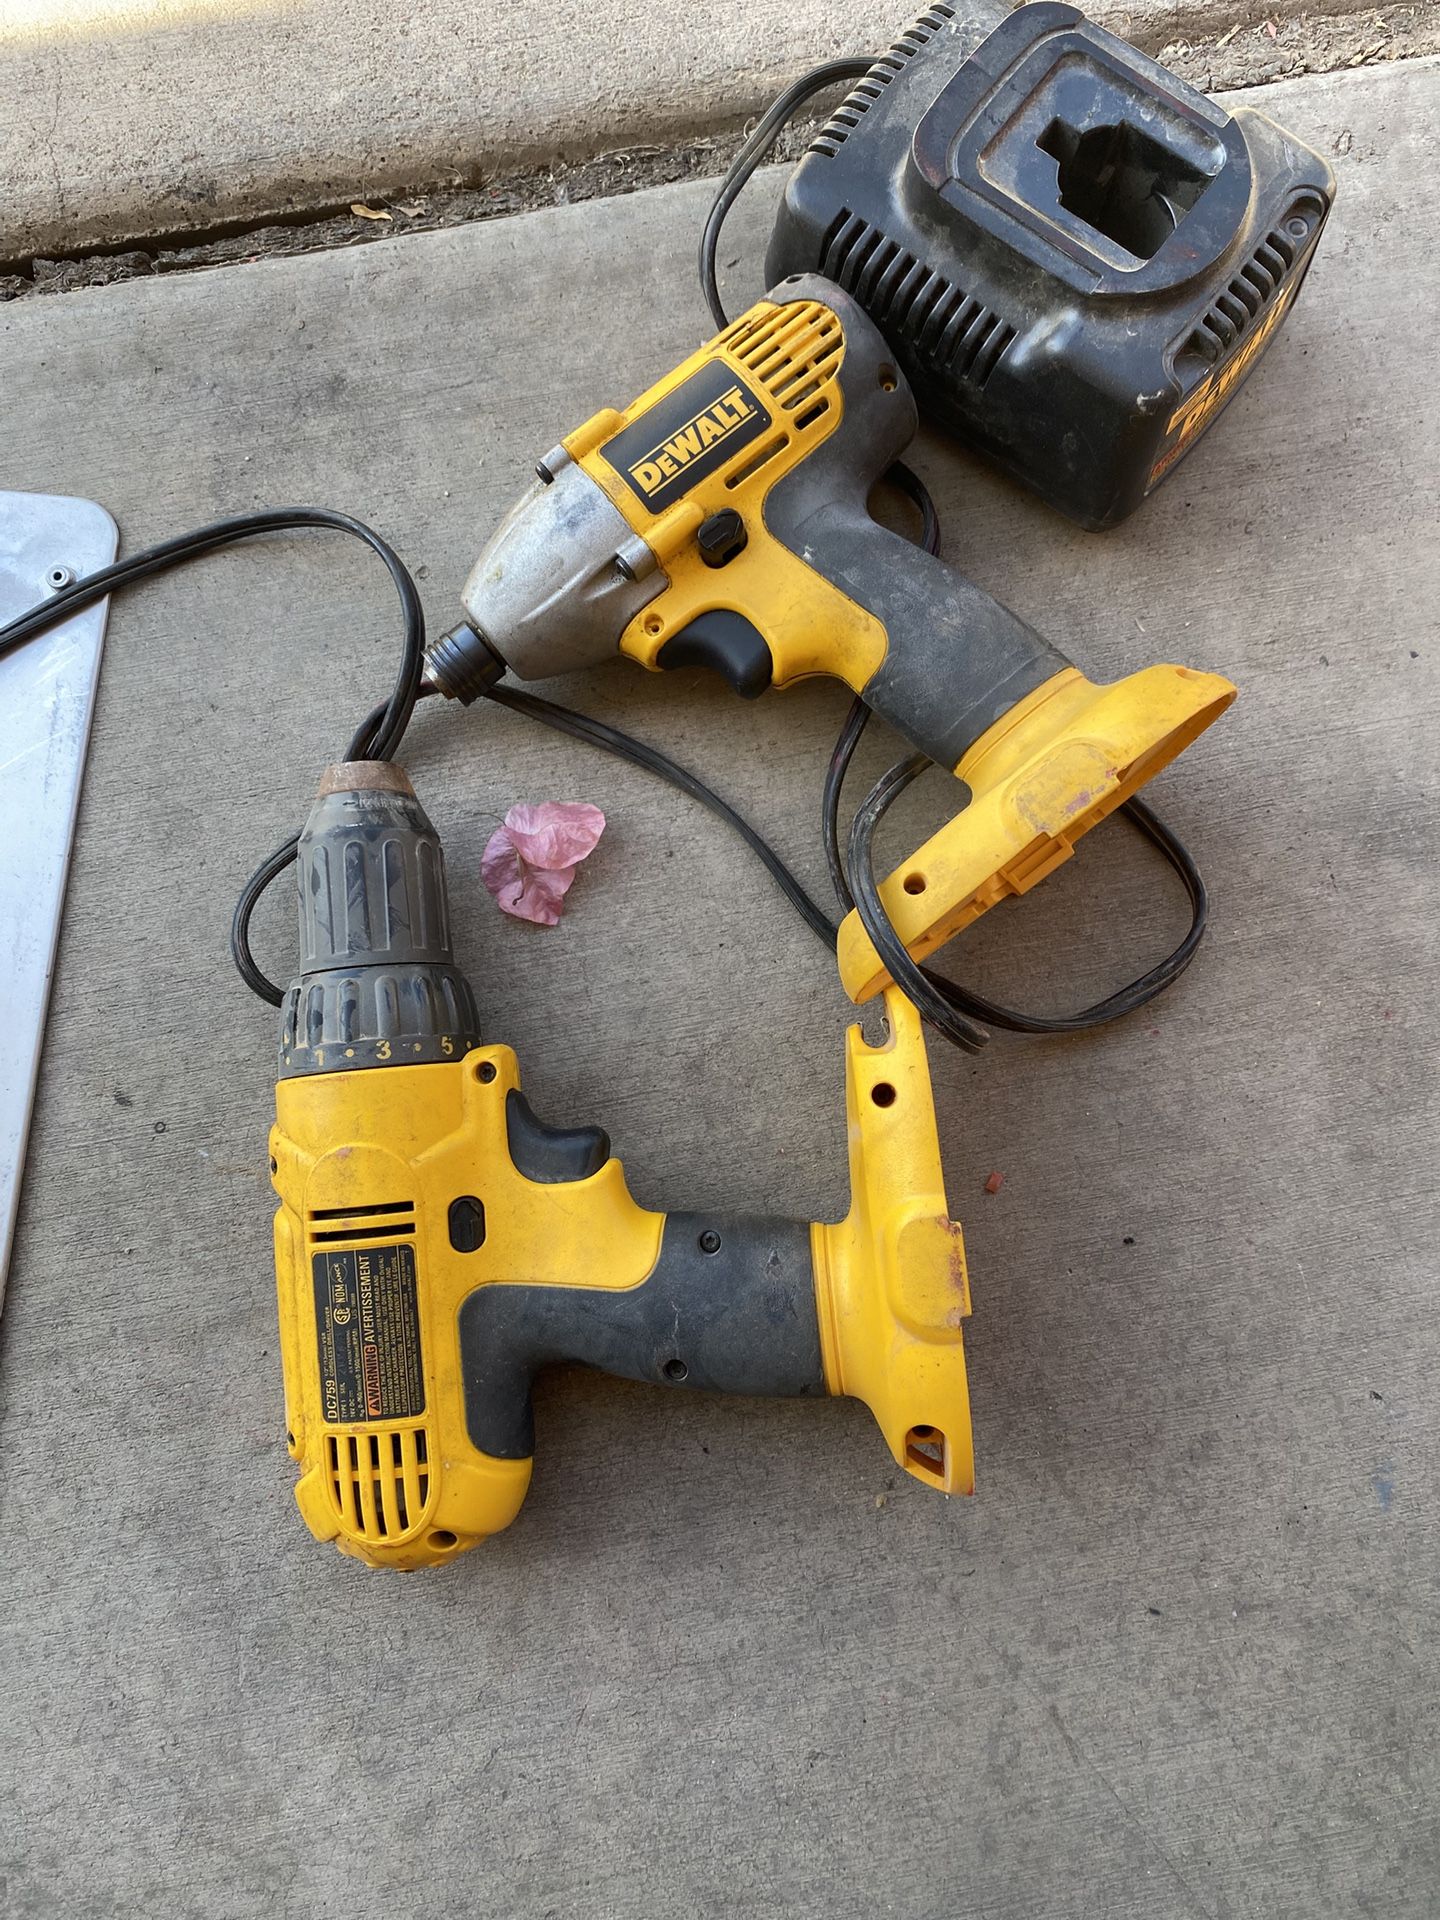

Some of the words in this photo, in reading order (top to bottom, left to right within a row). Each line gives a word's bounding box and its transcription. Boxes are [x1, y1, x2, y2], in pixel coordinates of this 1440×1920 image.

[630, 388, 750, 494] DEWALT
[314, 1051, 325, 1067] 1
[375, 1040, 391, 1060] 3
[441, 1036, 453, 1055] 5
[335, 1284, 346, 1303] NOM
[360, 1255, 375, 1342] AVERTISSEMENT
[366, 1347, 379, 1400] WARNING
[326, 1380, 338, 1419] DC759
